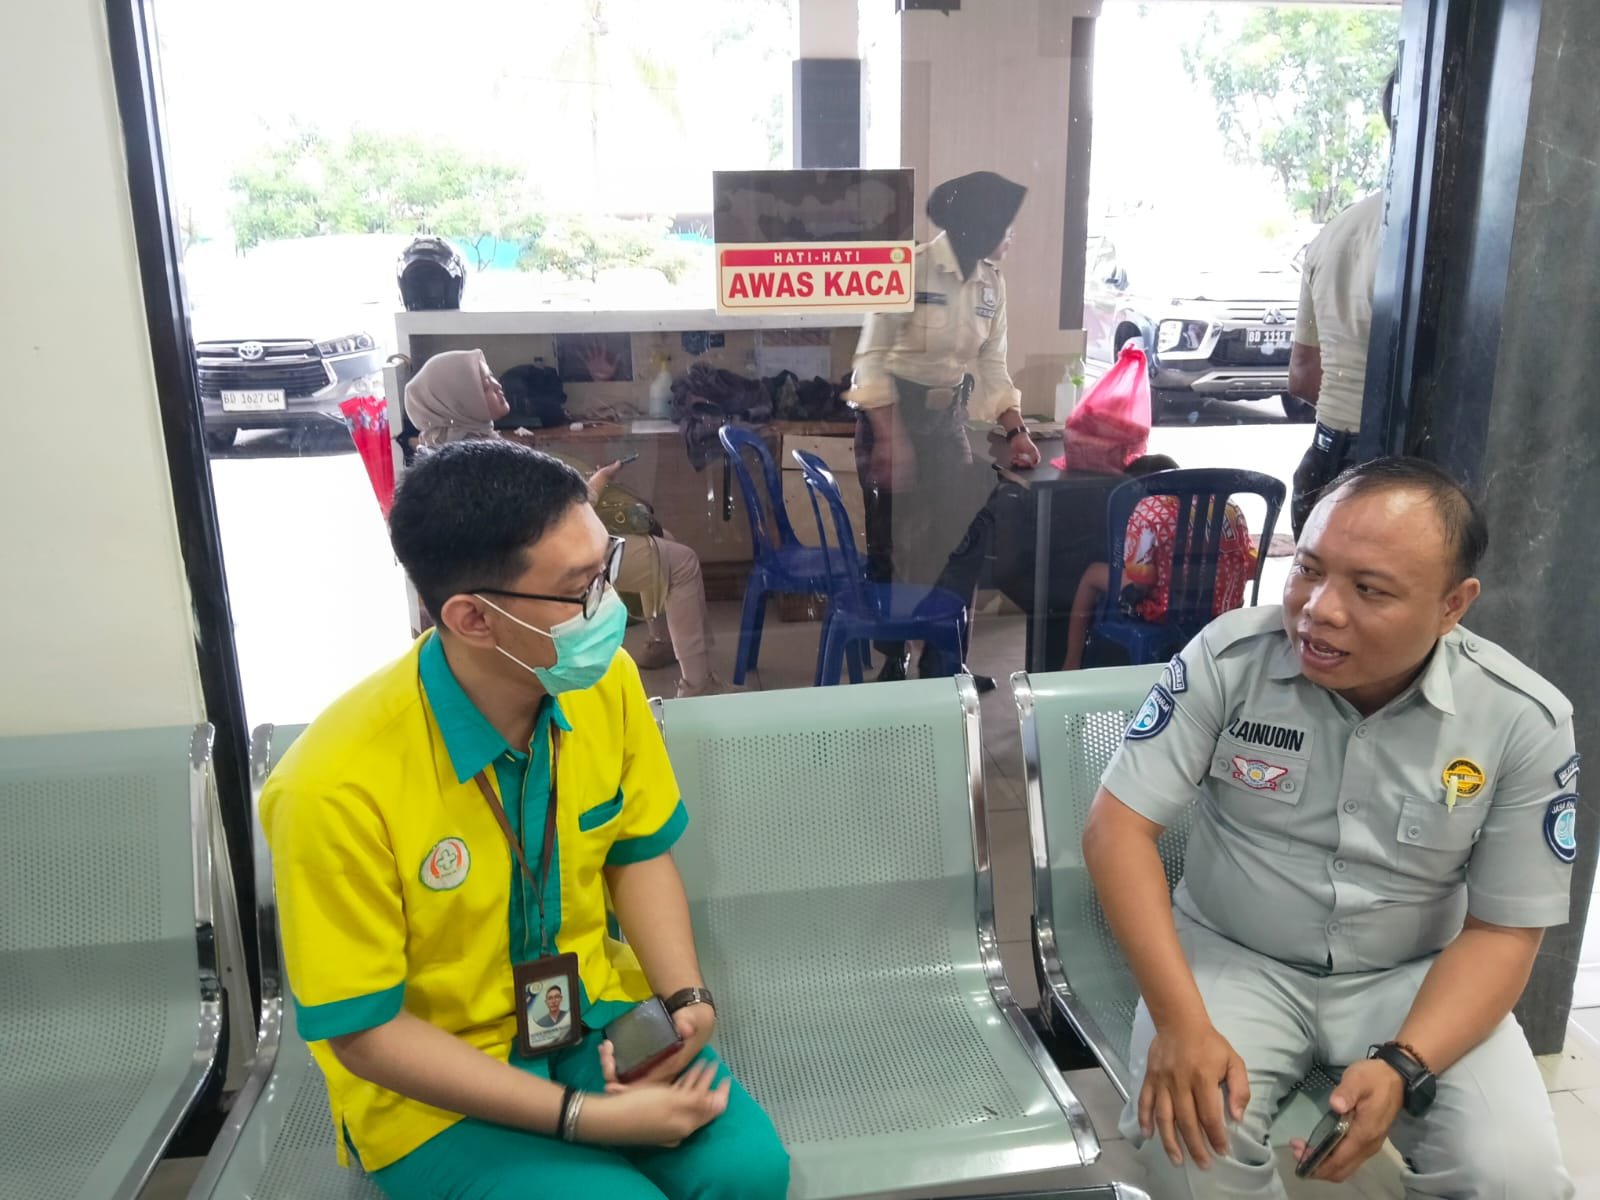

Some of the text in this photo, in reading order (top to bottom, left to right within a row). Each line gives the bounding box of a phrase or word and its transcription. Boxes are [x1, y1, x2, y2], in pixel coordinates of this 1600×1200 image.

[774, 251, 860, 263] HATI-HATI
[728, 270, 904, 298] AWAS KACA
[241, 392, 263, 404] 1627
